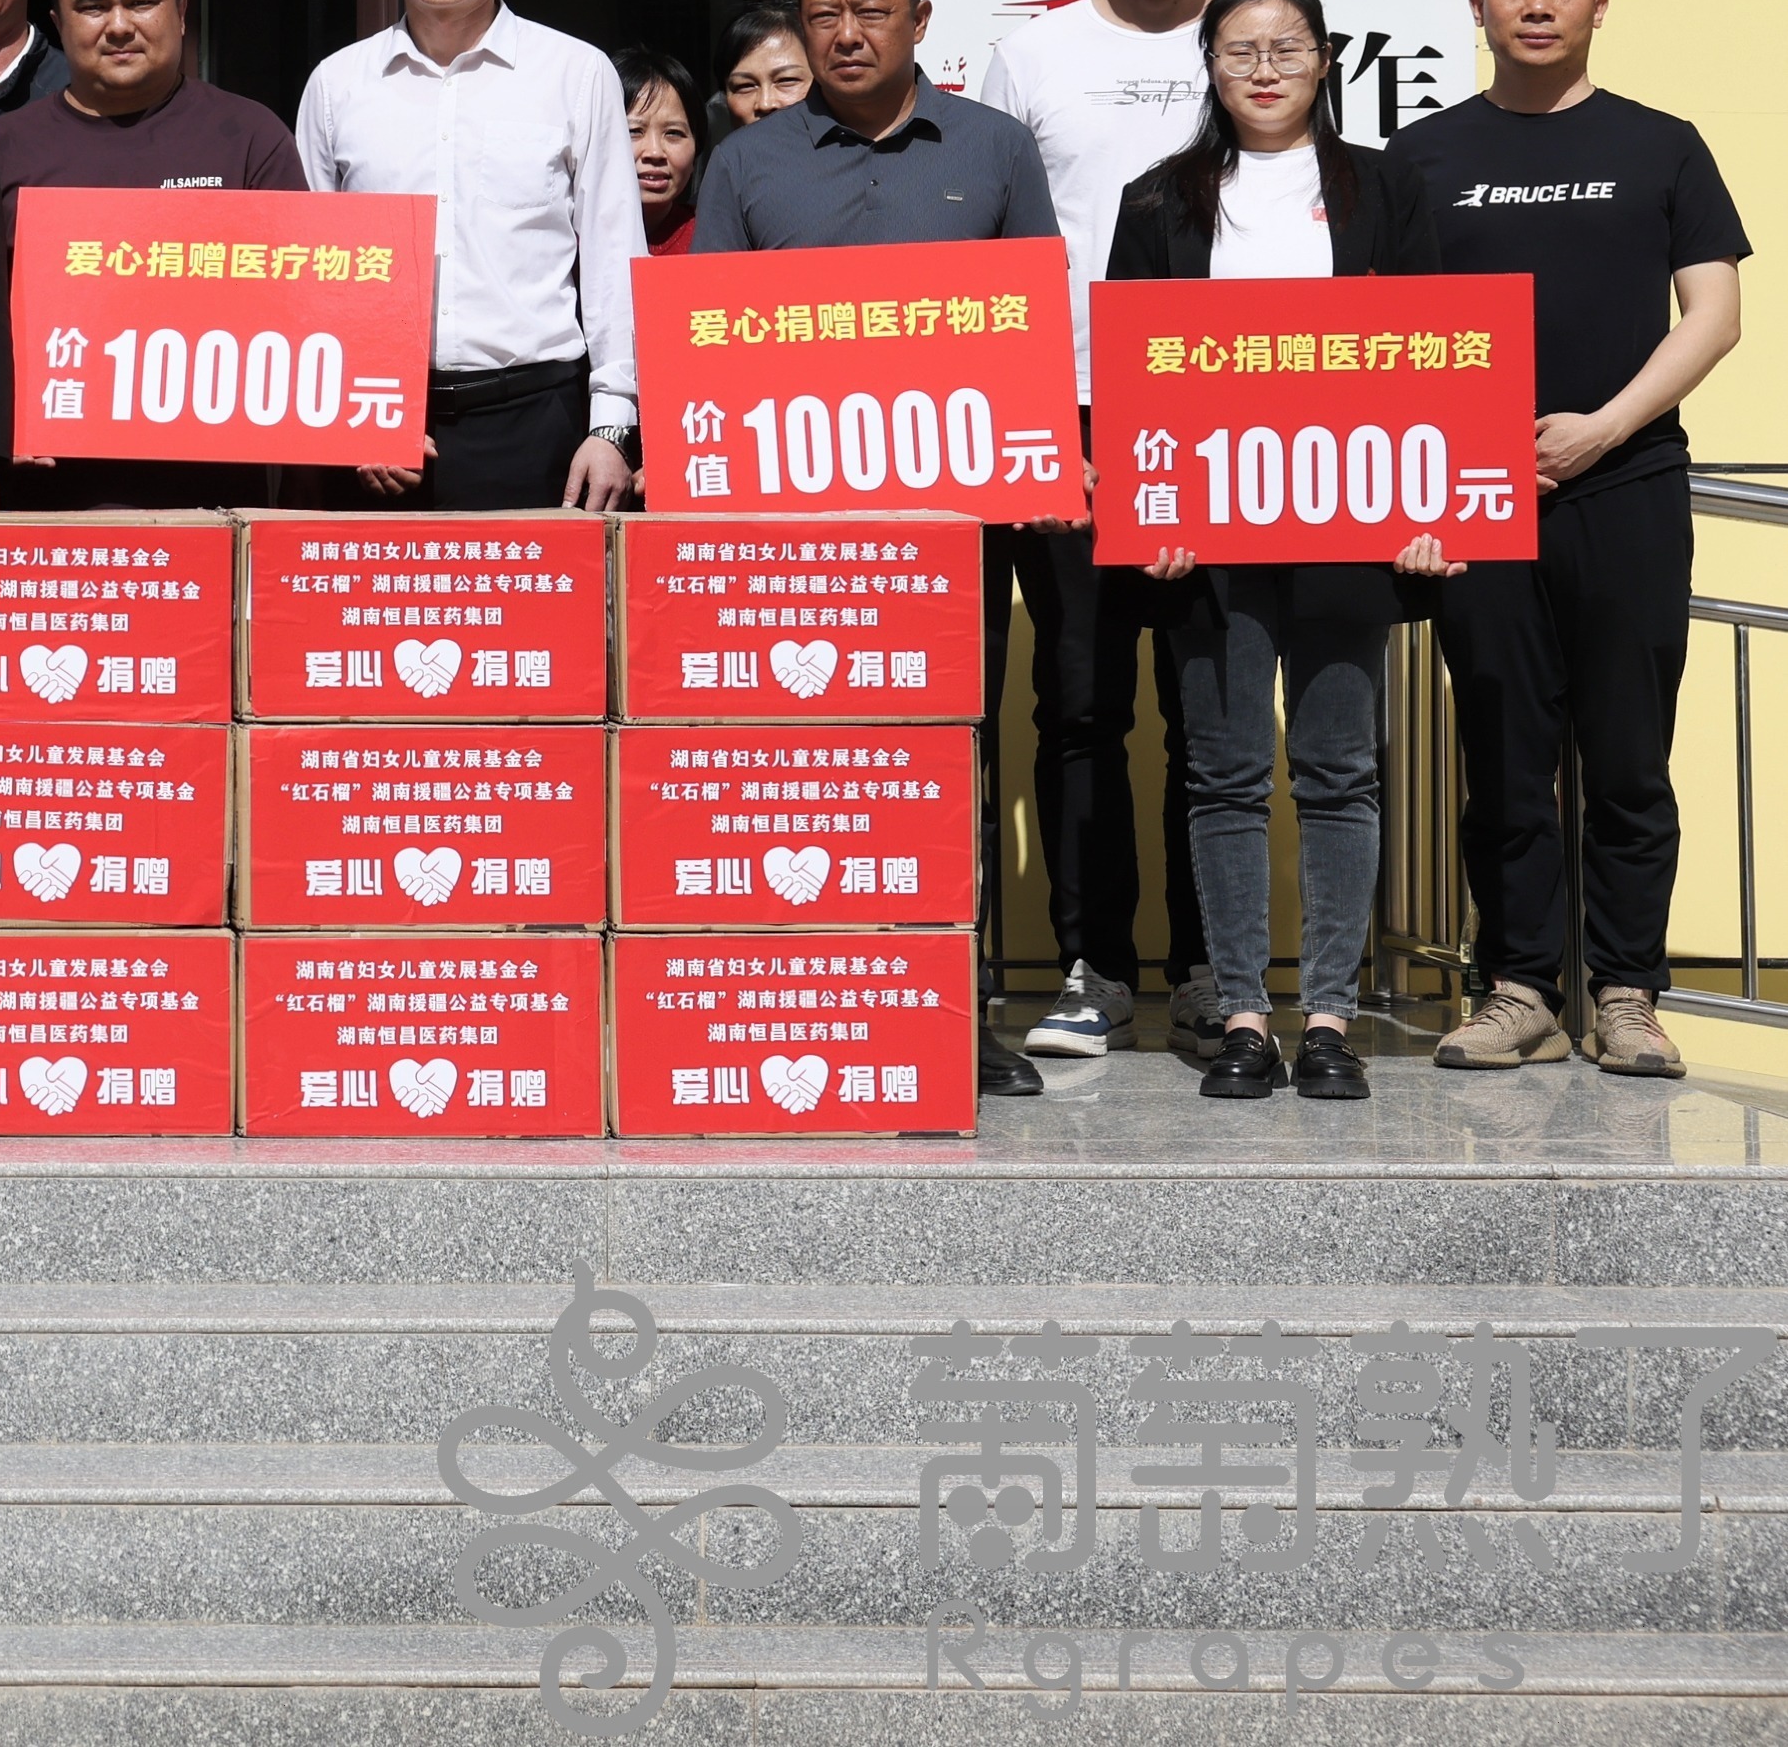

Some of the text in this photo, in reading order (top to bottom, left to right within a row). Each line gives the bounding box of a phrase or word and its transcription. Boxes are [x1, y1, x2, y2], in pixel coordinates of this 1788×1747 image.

[160, 176, 223, 190] JILSAHDER
[1488, 181, 1617, 204] BRUCE LEE
[67, 242, 390, 281] 爱心捐赠医疗物资
[690, 295, 1029, 347] 爱心捐赠医疗物资
[1146, 330, 1492, 375] 爱心捐赠医疗物资
[301, 541, 543, 561] 湖南省妇女儿童发展基金会
[341, 606, 502, 626] 湖南恒昌医药集团
[305, 649, 551, 688] 爱心 捐赠
[670, 748, 910, 769] 湖南省妇女儿童发展基金会
[711, 813, 870, 834] 湖南恒昌医药集团
[89, 855, 169, 895] 捐赠
[675, 856, 918, 895] 爱心 捐赠
[295, 959, 538, 980] 湖南省妇女儿童发展基金会
[336, 1025, 498, 1046] 湖南恒昌医药集团
[300, 1069, 546, 1108] 爱心 捐赠
